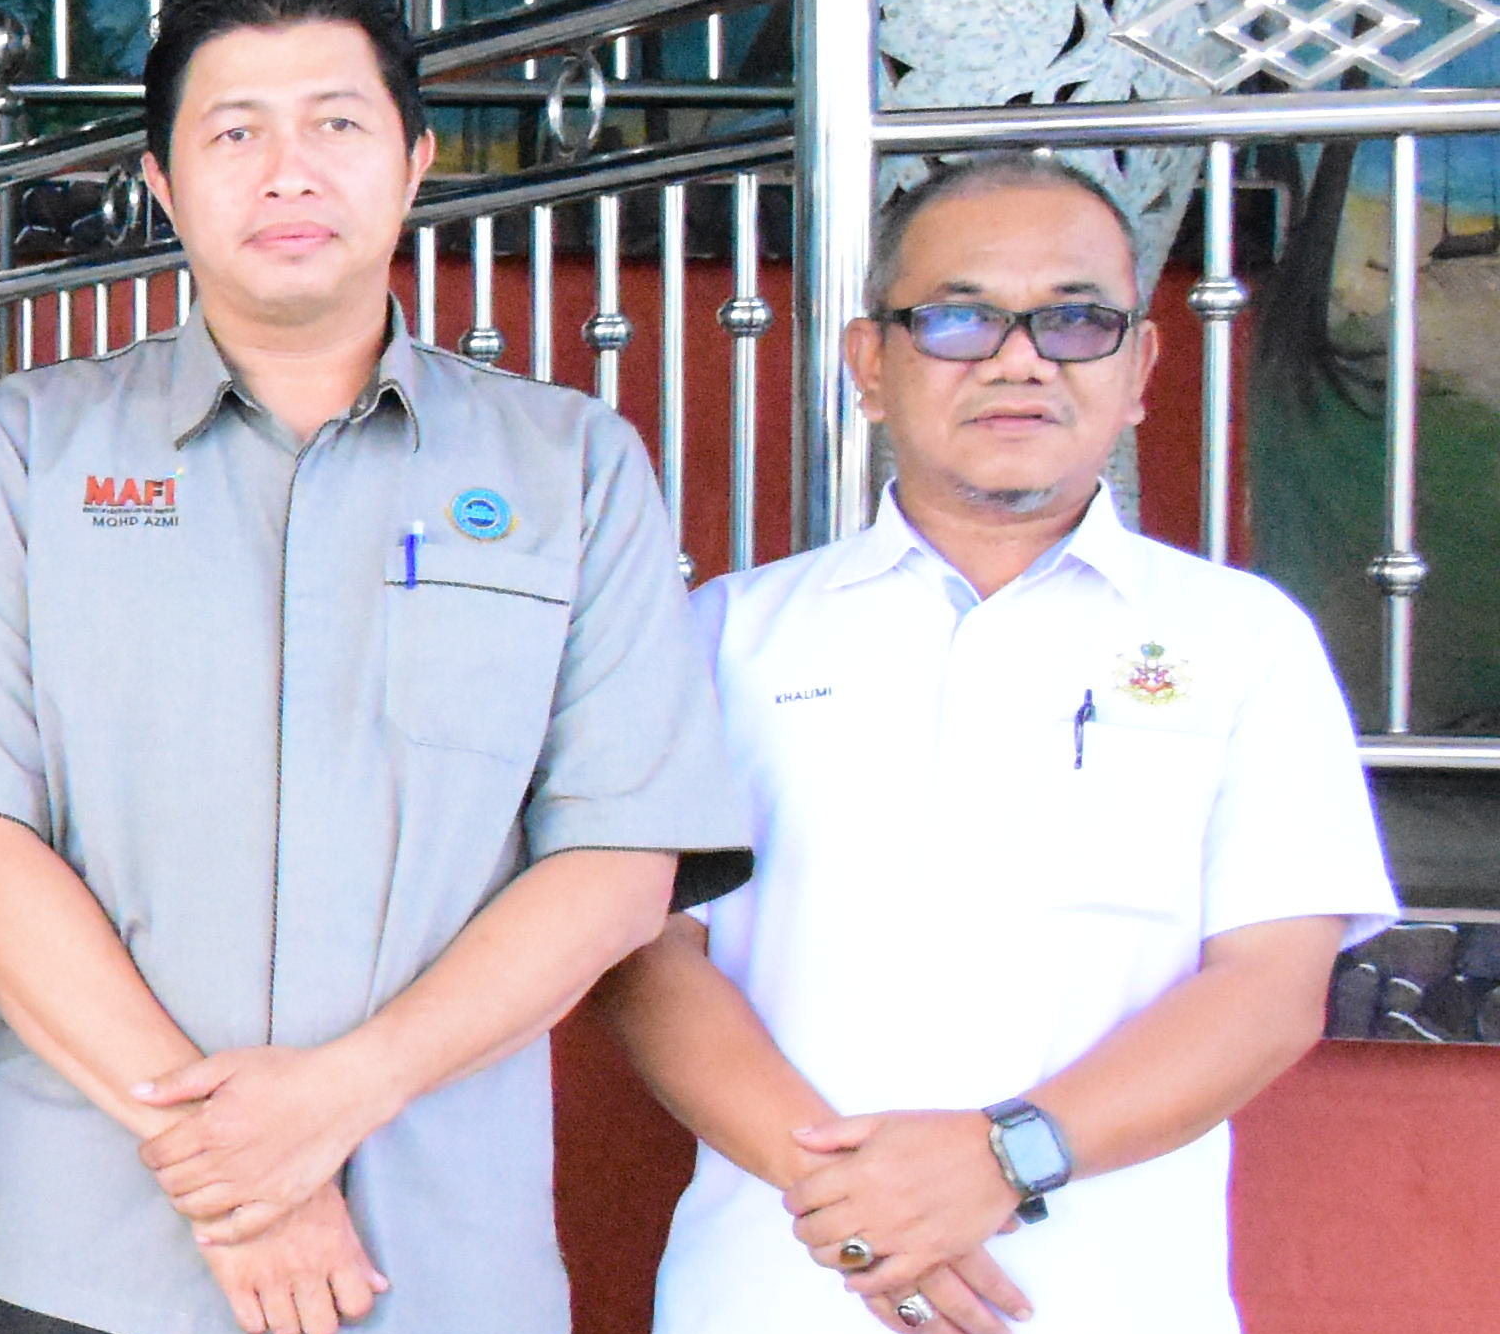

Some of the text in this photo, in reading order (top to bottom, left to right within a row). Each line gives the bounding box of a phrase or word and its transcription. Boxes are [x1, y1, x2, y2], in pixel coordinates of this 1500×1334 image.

[84, 475, 176, 507] MAFI
[92, 514, 180, 528] MOHD AZMI
